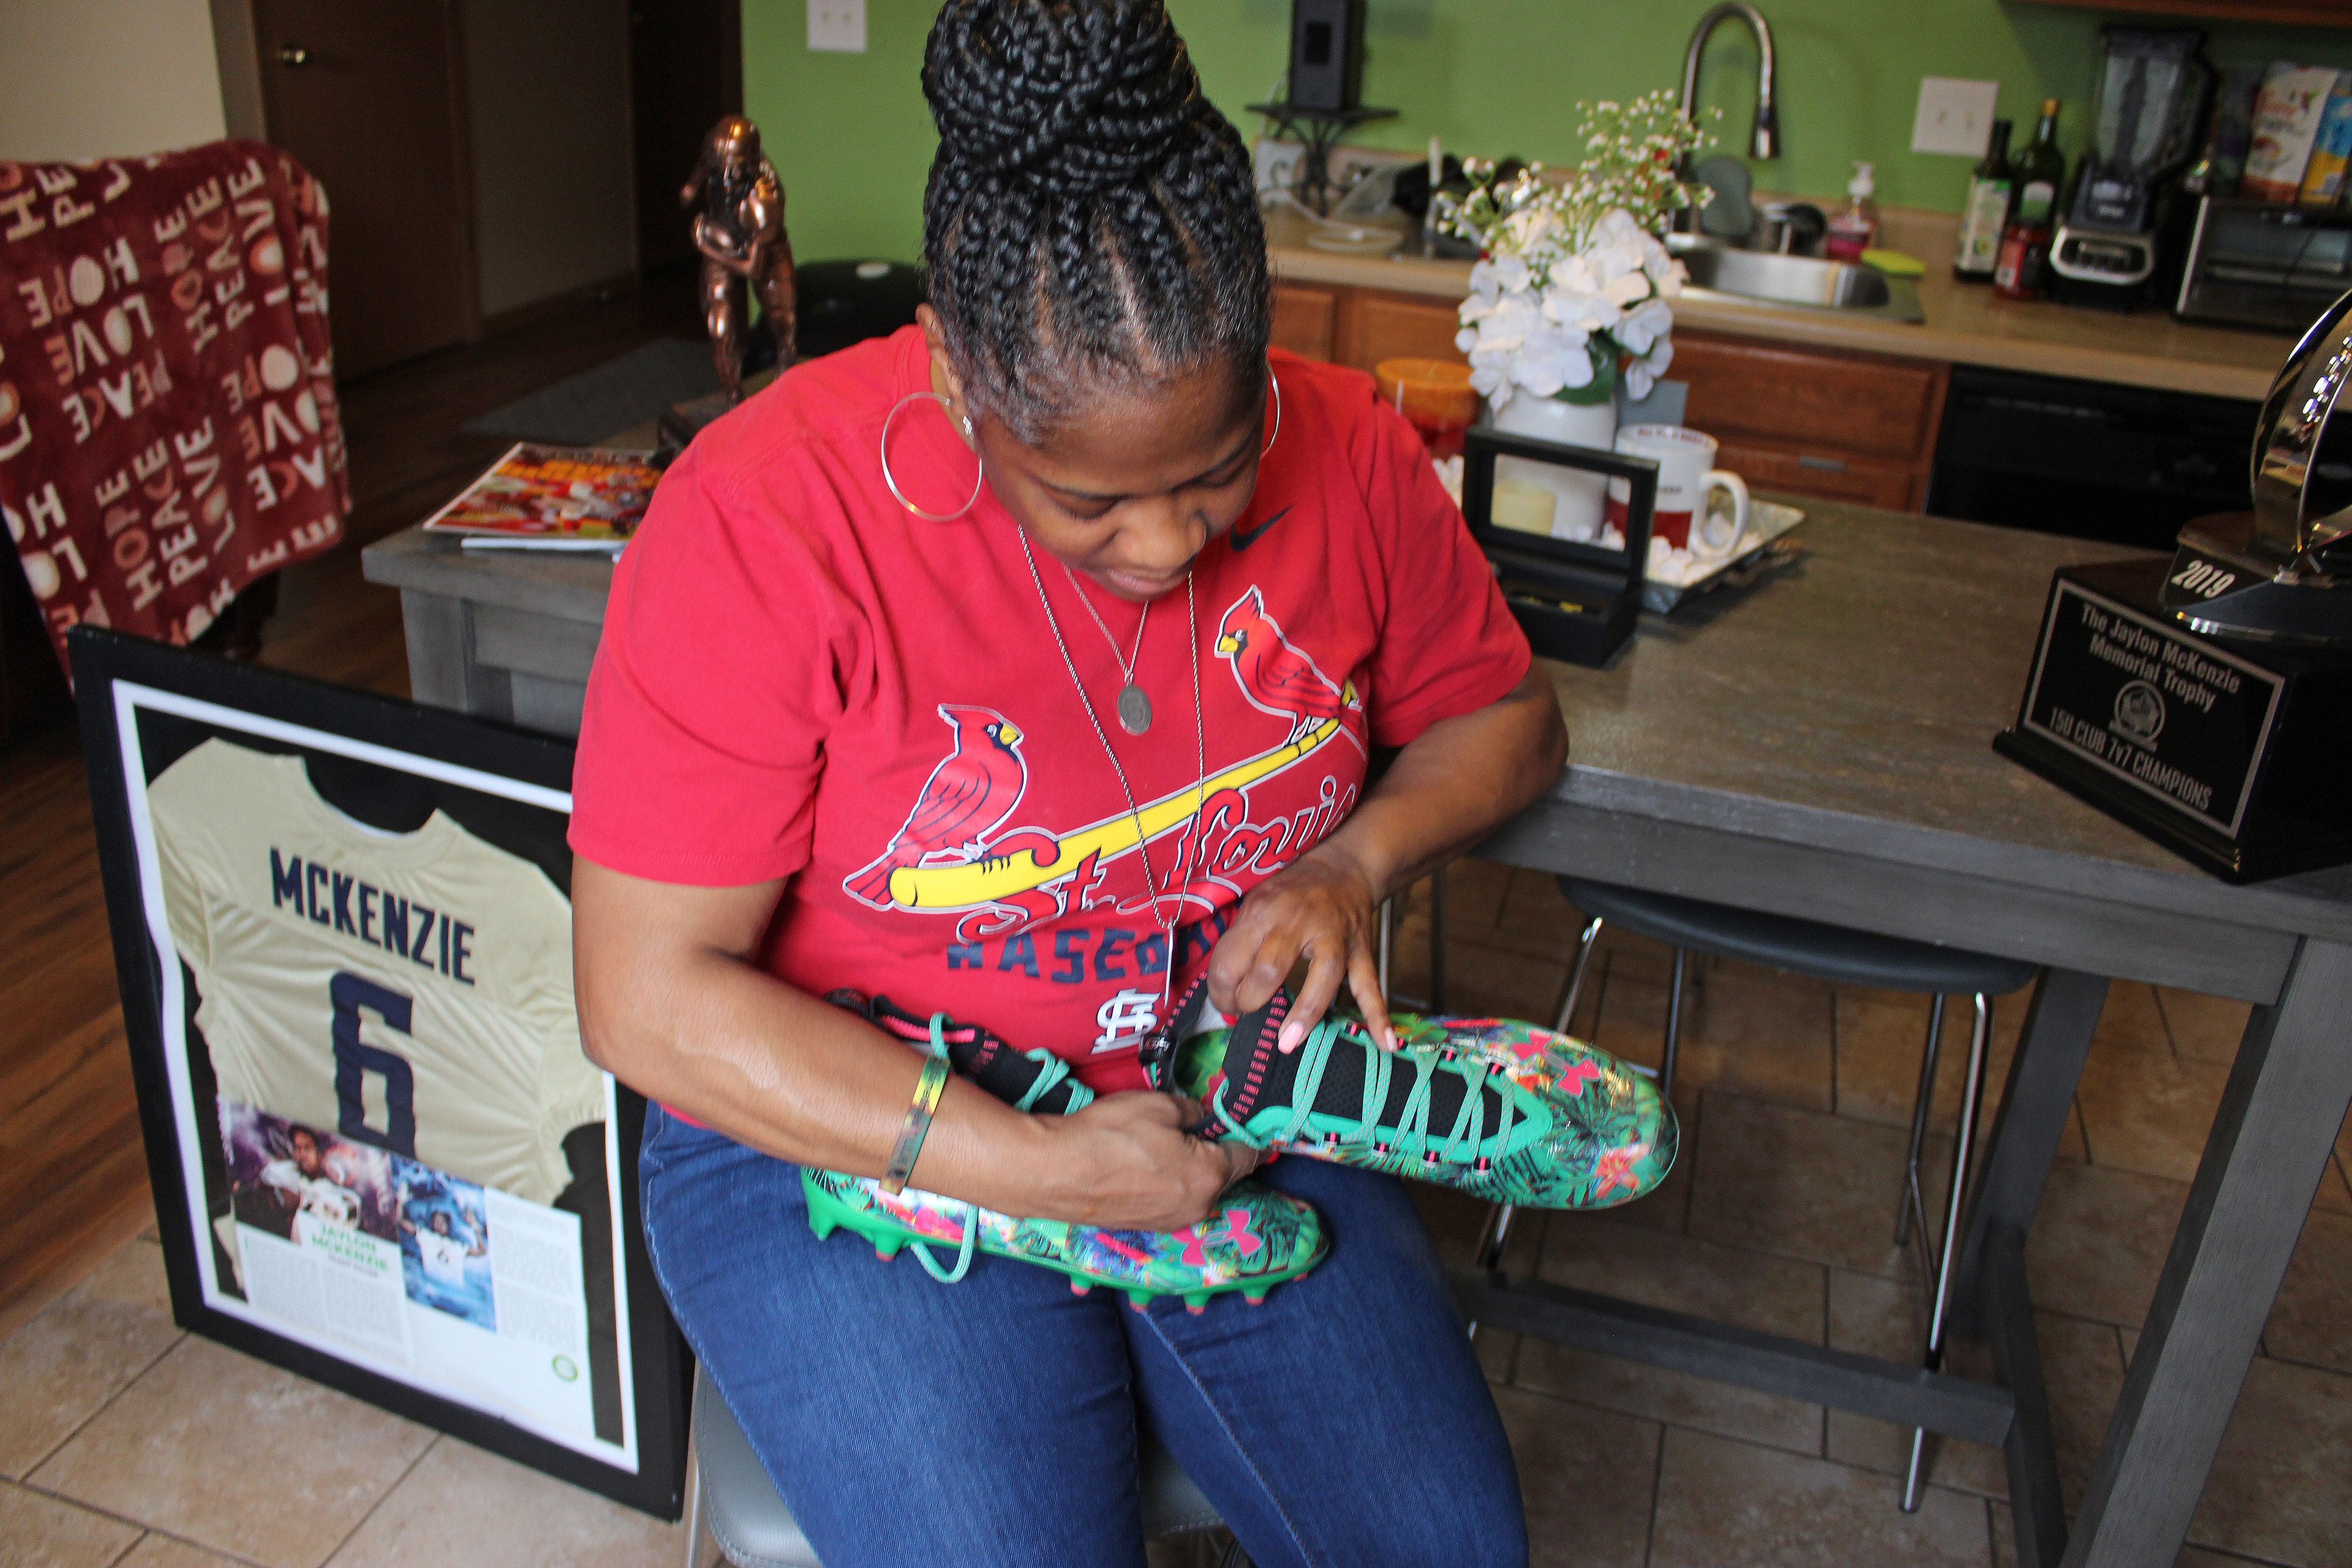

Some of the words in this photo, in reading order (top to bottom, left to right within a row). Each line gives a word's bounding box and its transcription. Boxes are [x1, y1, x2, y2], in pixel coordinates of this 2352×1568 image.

[18, 236, 140, 328] HOPE
[153, 206, 219, 353] HOPE
[185, 177, 255, 330] PEACE
[44, 293, 154, 386] LOVE
[221, 337, 307, 414] OPE
[62, 349, 173, 444] PEACE
[239, 388, 321, 461] OVE
[132, 438, 208, 587] PEACE
[174, 417, 236, 554] LOVE
[94, 470, 164, 611] HOPE
[2171, 559, 2236, 598] 2019
[2082, 603, 2108, 632] The
[2110, 617, 2159, 657] Jaylon
[2162, 640, 2241, 695] McKenzie
[2089, 632, 2162, 683] Memorial
[2163, 667, 2217, 714] Trophy
[2073, 720, 2107, 755] CLUB
[2132, 750, 2213, 811] CHAMPIONS
[270, 845, 475, 986] MCKENZIE
[329, 970, 417, 1162] 6
